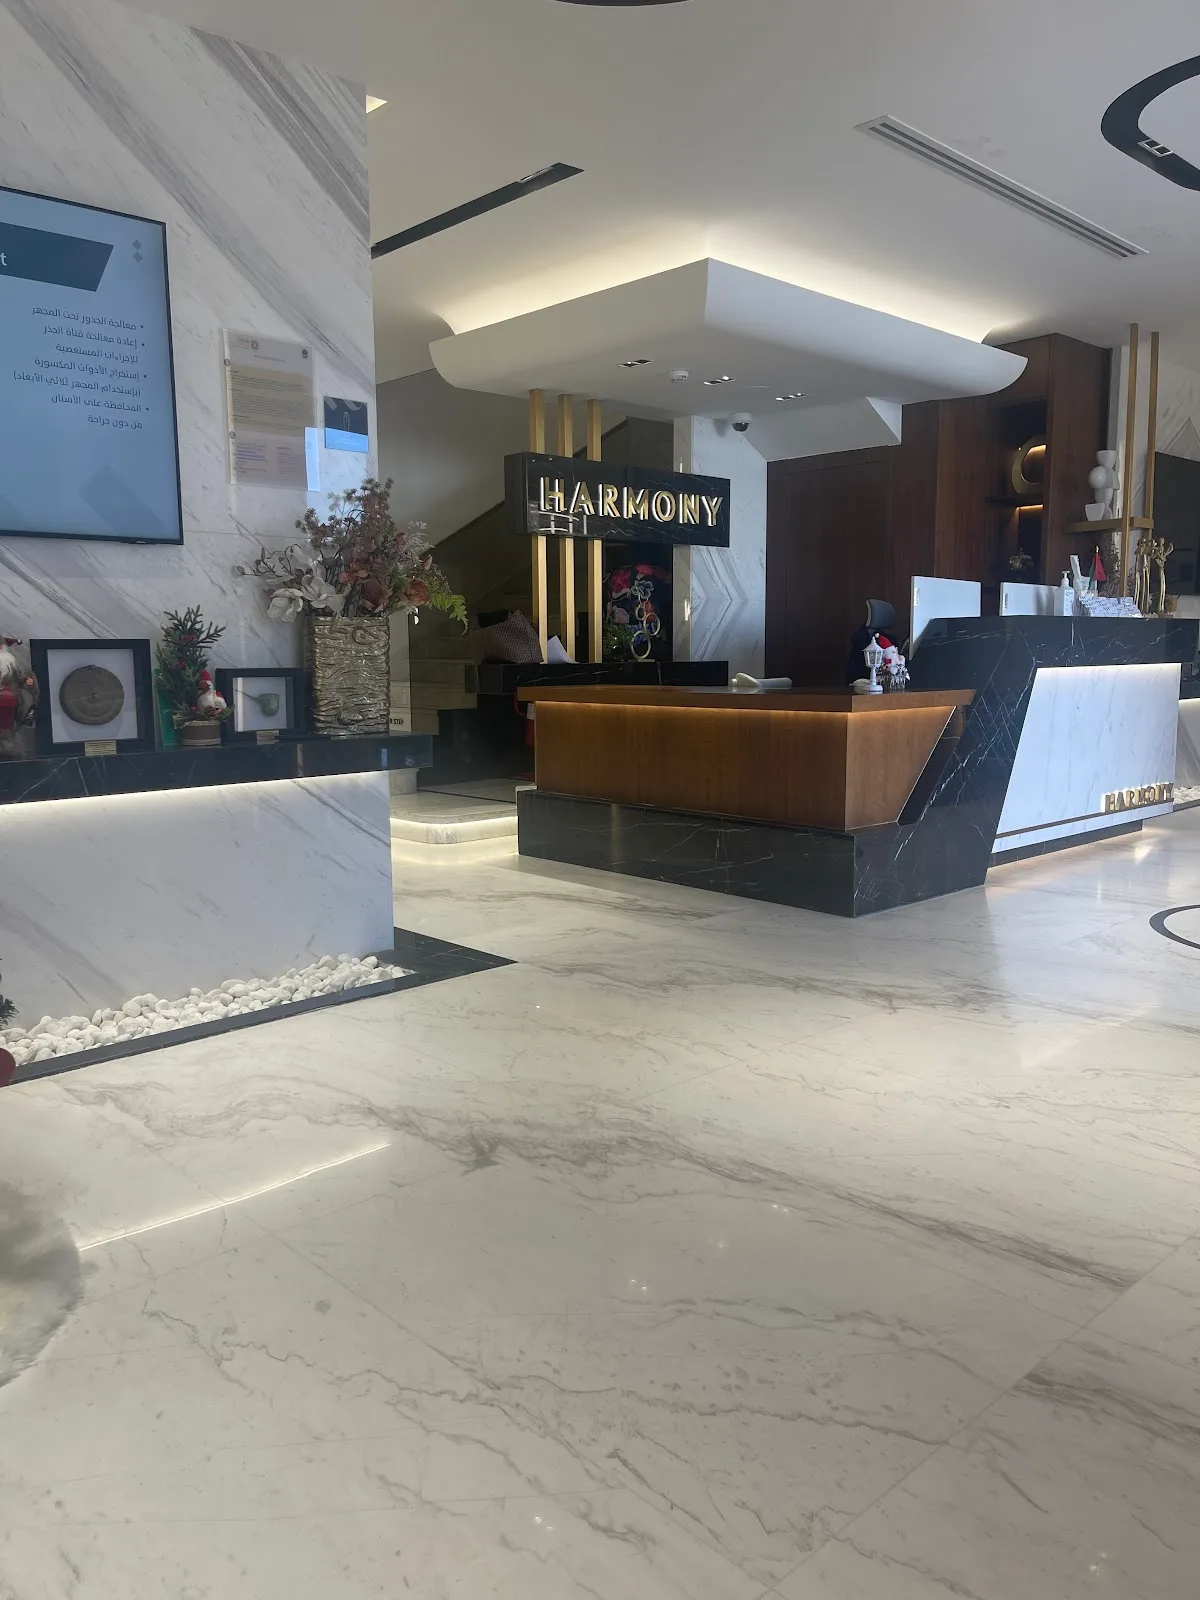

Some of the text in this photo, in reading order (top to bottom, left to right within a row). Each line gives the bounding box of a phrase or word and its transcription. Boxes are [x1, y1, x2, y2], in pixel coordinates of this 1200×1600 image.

[43, 324, 63, 336] الجذر
[55, 343, 103, 358] المستعصية
[116, 337, 138, 350] إعادة
[34, 357, 75, 371] المكسورة
[51, 392, 142, 412] المحافظة على الأسنان
[112, 419, 129, 429] دون
[131, 421, 143, 430] من
[539, 476, 724, 528] HARMONY
[1103, 782, 1174, 813] HARMONY
